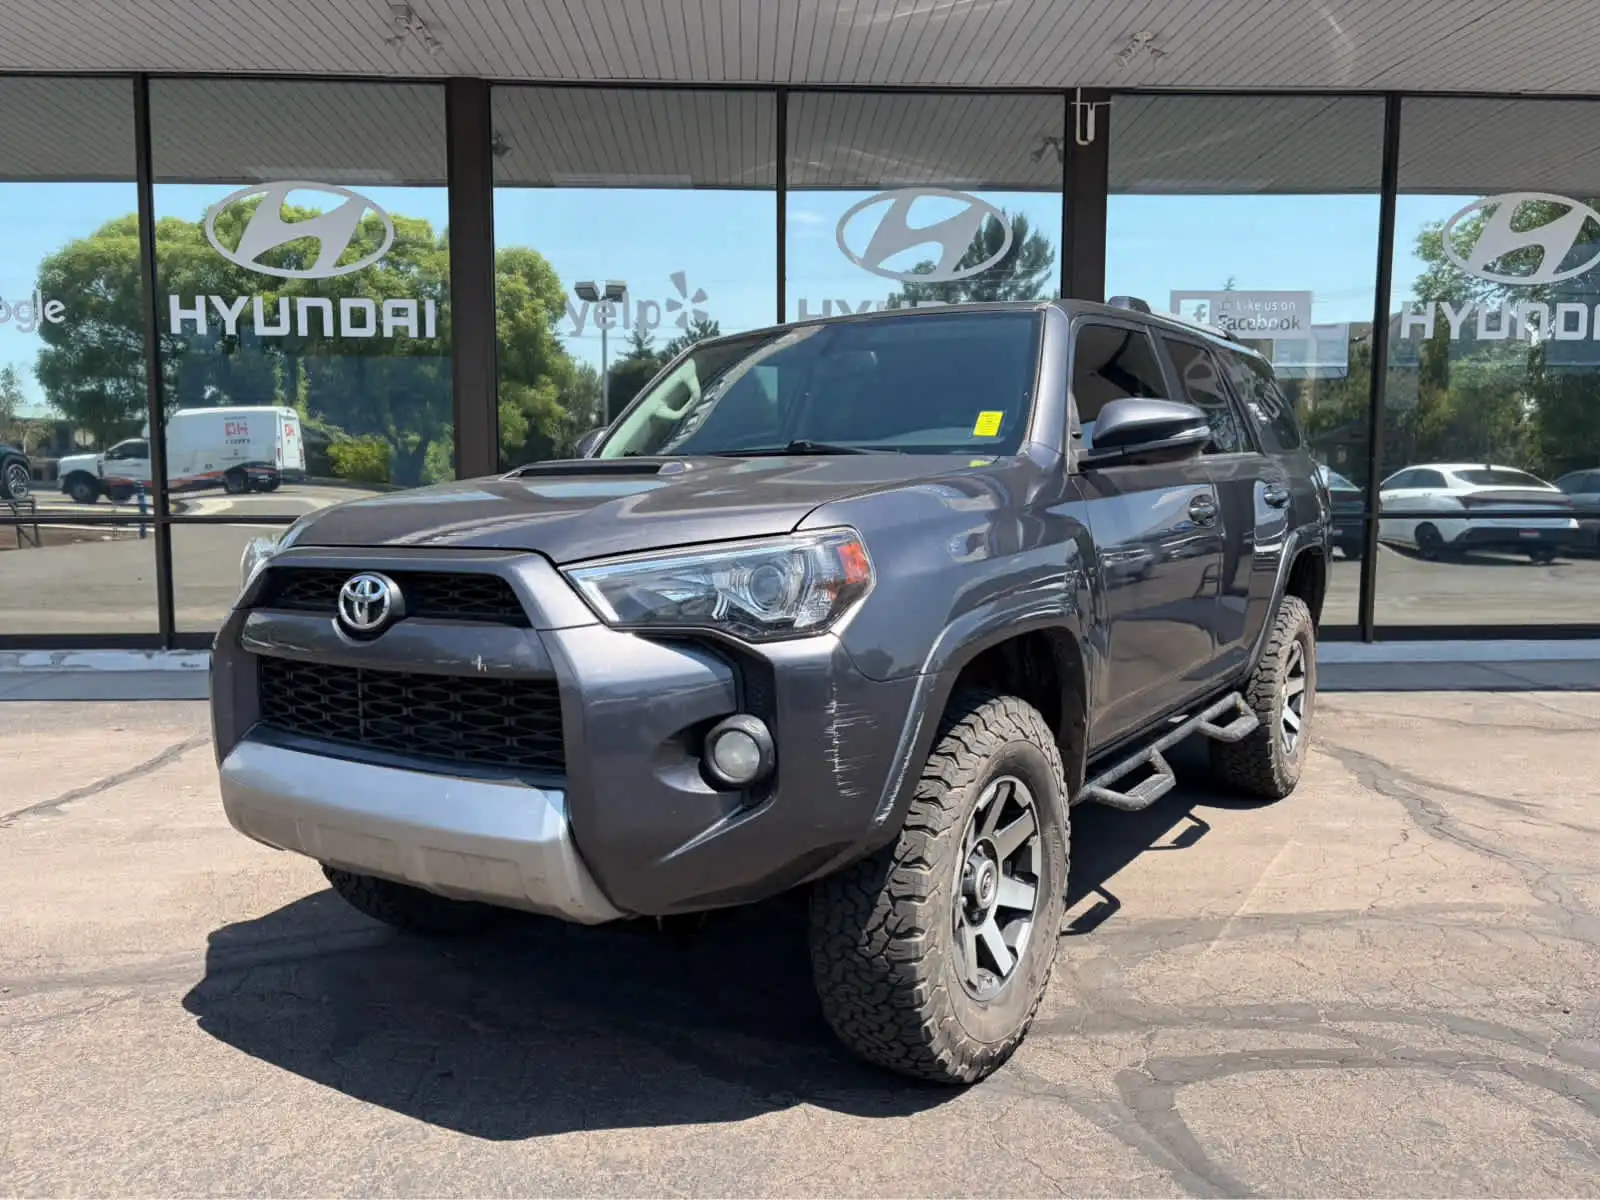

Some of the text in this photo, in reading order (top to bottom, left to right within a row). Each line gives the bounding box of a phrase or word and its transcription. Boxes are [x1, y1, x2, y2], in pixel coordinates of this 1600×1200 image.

[168, 294, 436, 338] HYUNDAI
[564, 291, 661, 339] yelp
[1217, 313, 1300, 331] Facebook
[1264, 301, 1278, 311] us
[1281, 301, 1296, 311] on
[1400, 301, 1600, 340] HYUND
